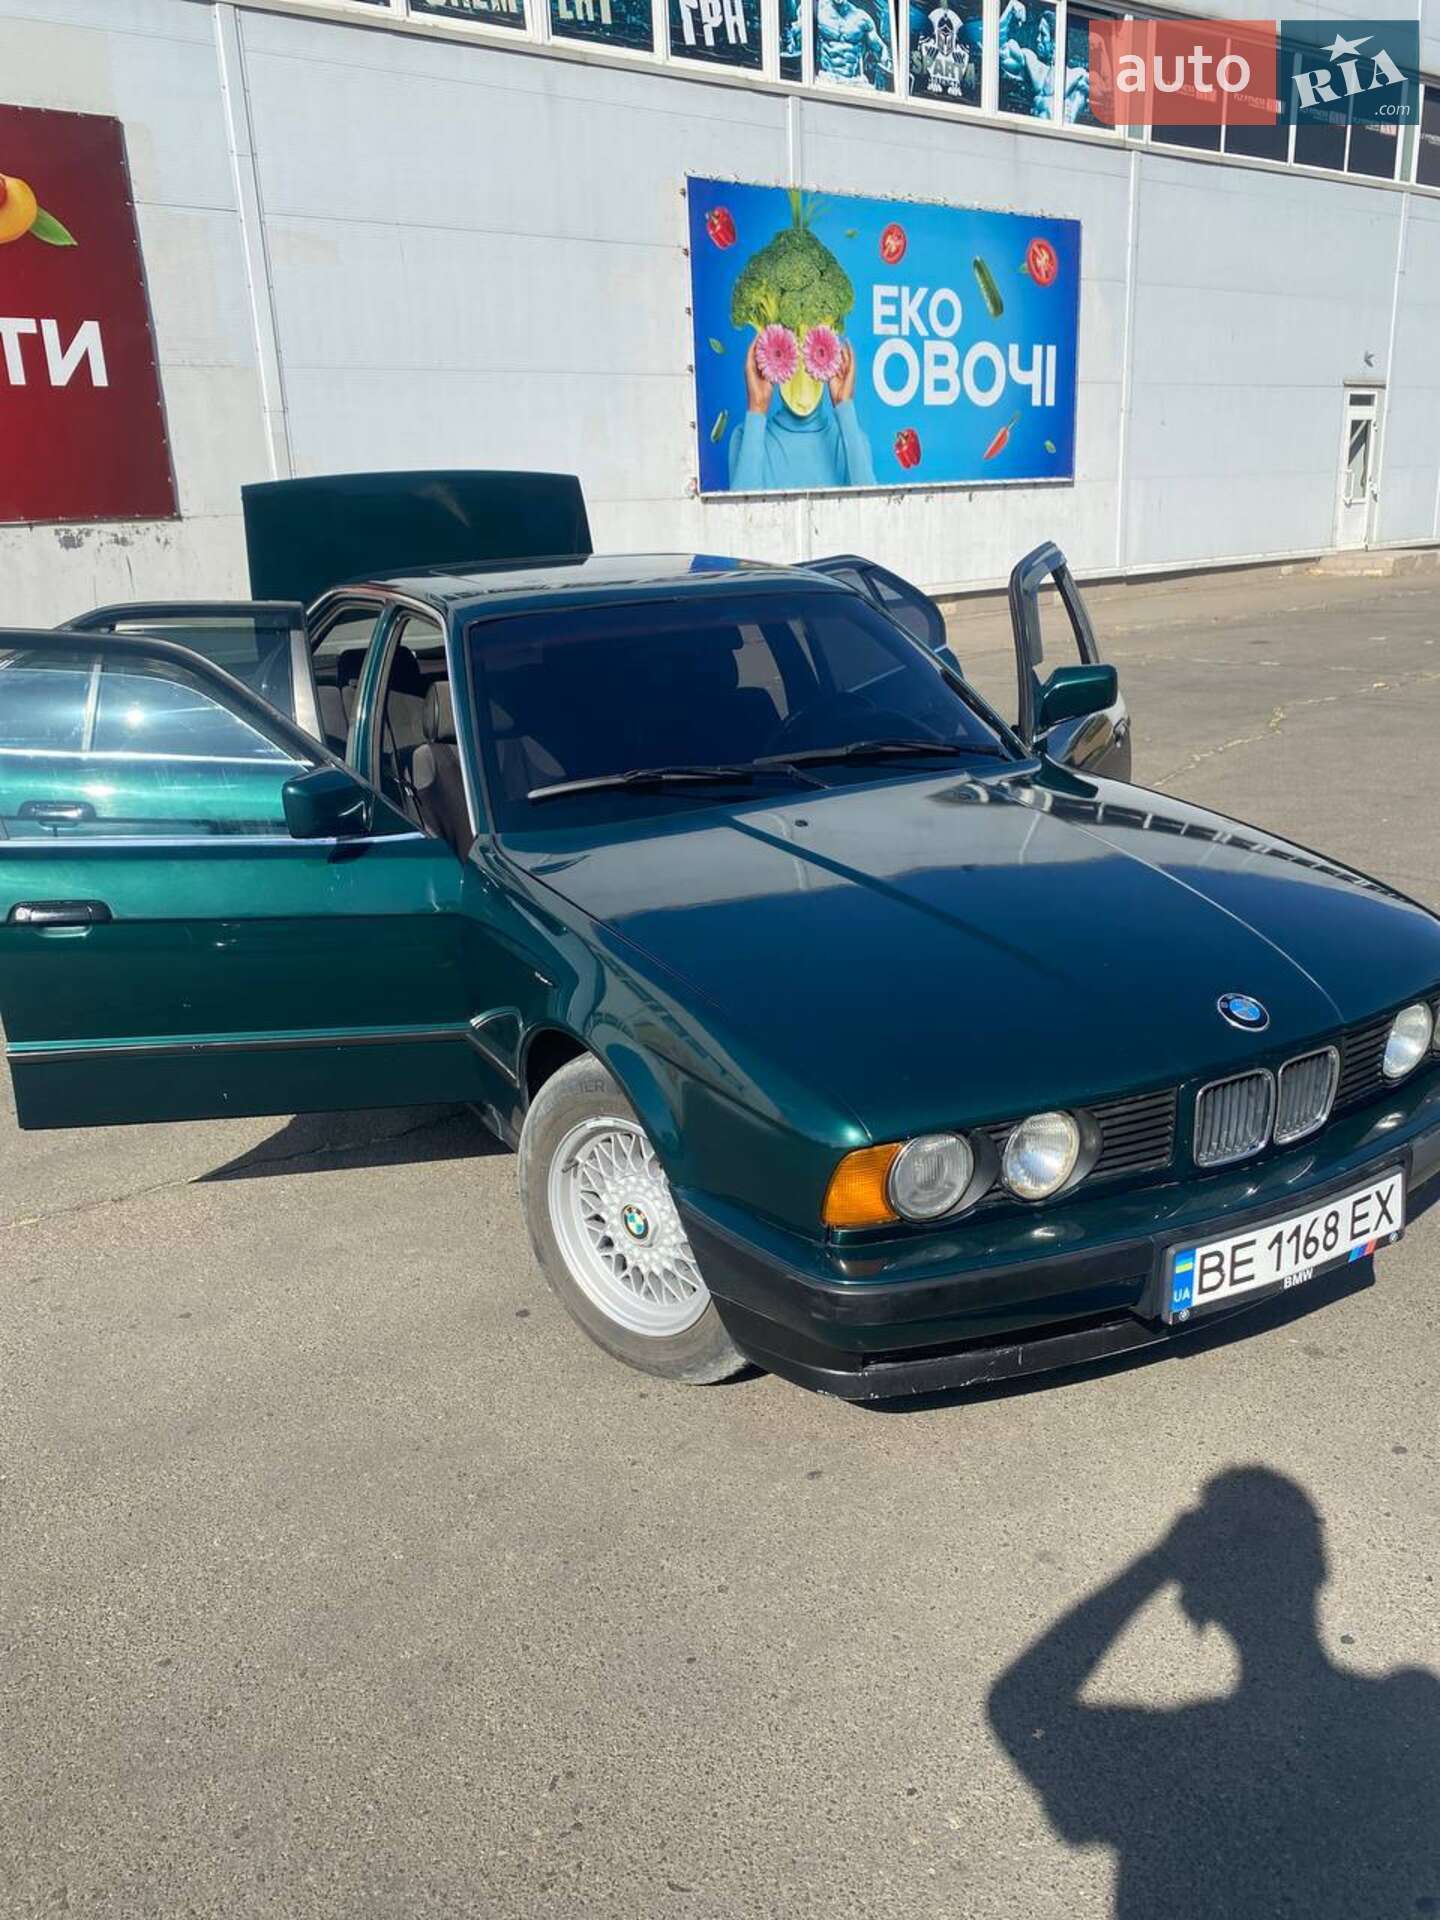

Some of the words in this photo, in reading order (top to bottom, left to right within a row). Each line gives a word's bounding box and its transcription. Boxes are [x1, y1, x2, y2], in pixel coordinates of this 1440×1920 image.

[872, 284, 963, 338] ЕКО
[872, 338, 1057, 407] ОВОЧІ
[1198, 1239, 1256, 1295] BE
[1267, 1209, 1340, 1272] 1168
[1350, 1184, 1395, 1241] EX
[1173, 1290, 1192, 1303] UA
[1283, 1267, 1314, 1290] BMW
